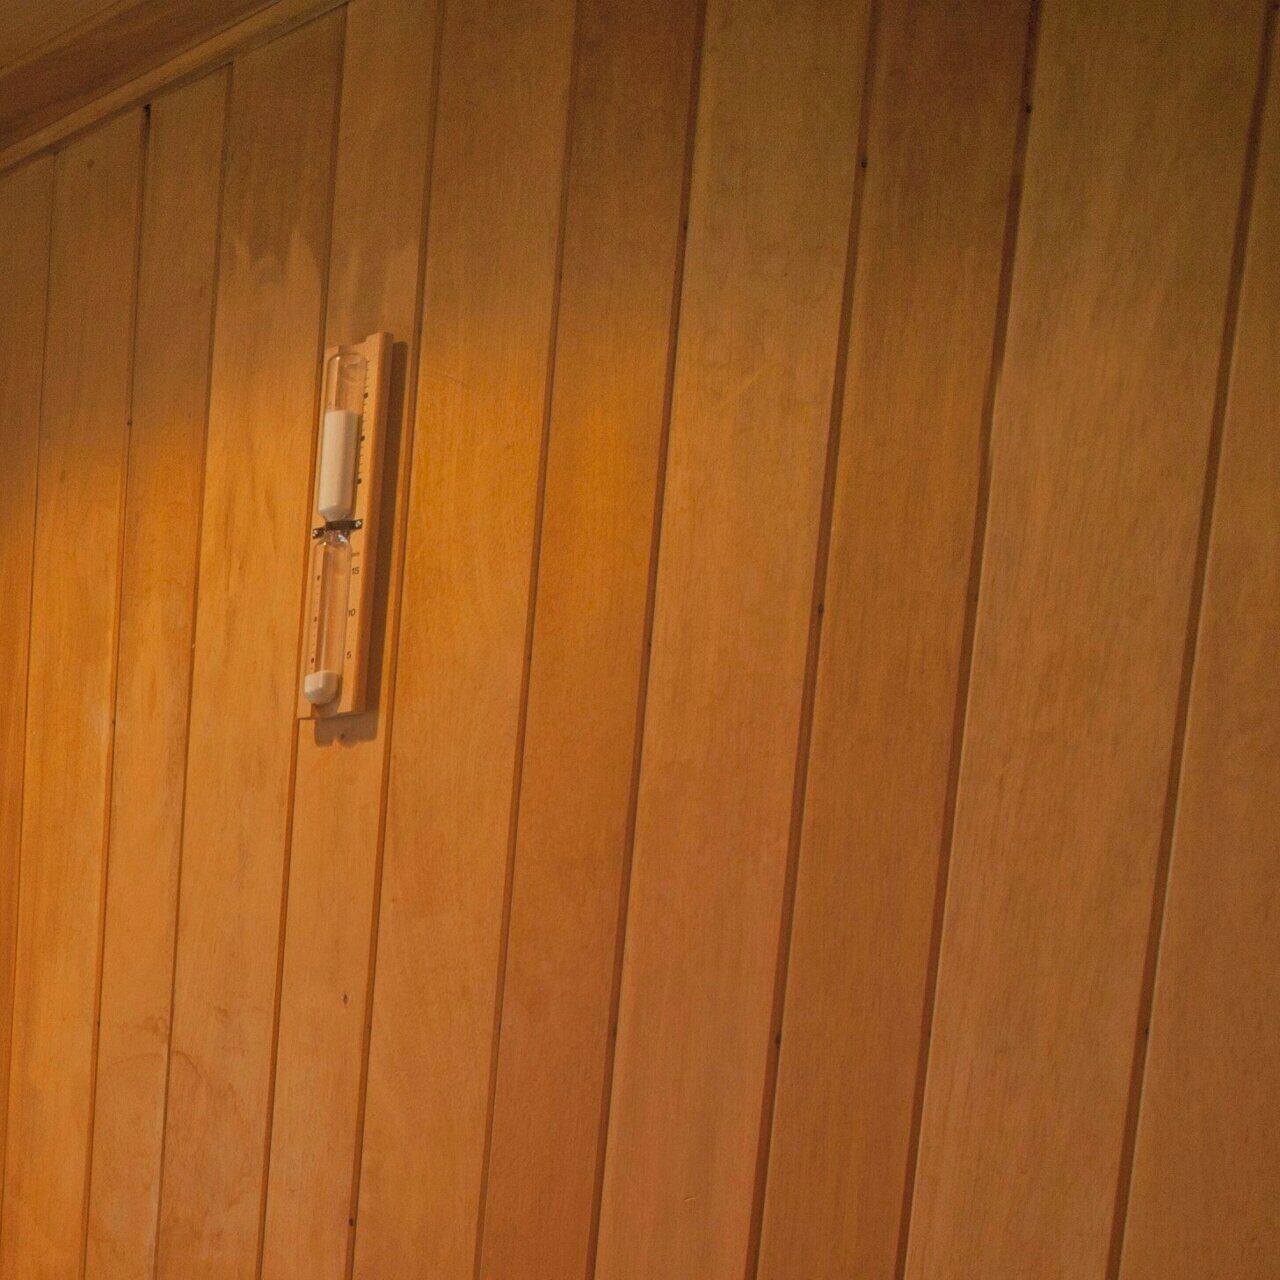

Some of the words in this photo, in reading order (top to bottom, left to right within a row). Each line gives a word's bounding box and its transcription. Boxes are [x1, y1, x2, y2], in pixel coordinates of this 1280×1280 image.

[351, 567, 360, 575] 15
[348, 608, 356, 617] 10
[346, 651, 352, 660] 5
